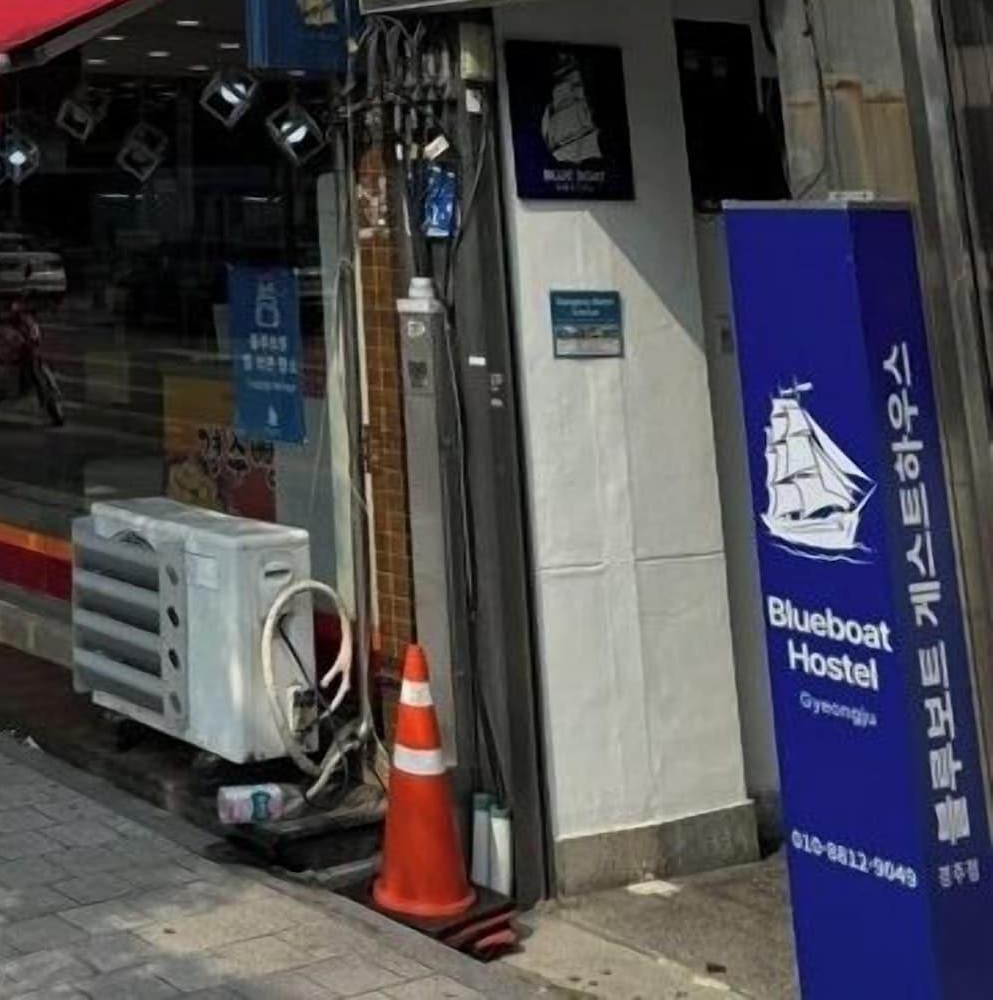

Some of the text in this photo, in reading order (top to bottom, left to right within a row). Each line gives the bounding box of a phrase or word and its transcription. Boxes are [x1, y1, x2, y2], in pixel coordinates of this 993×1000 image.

[882, 342, 971, 845] 블루보트 게스트하우스
[766, 595, 893, 653] Blueboat
[787, 638, 880, 692] Hostel
[799, 690, 878, 727] Gyeongju
[791, 829, 918, 889] 010-8812-9049
